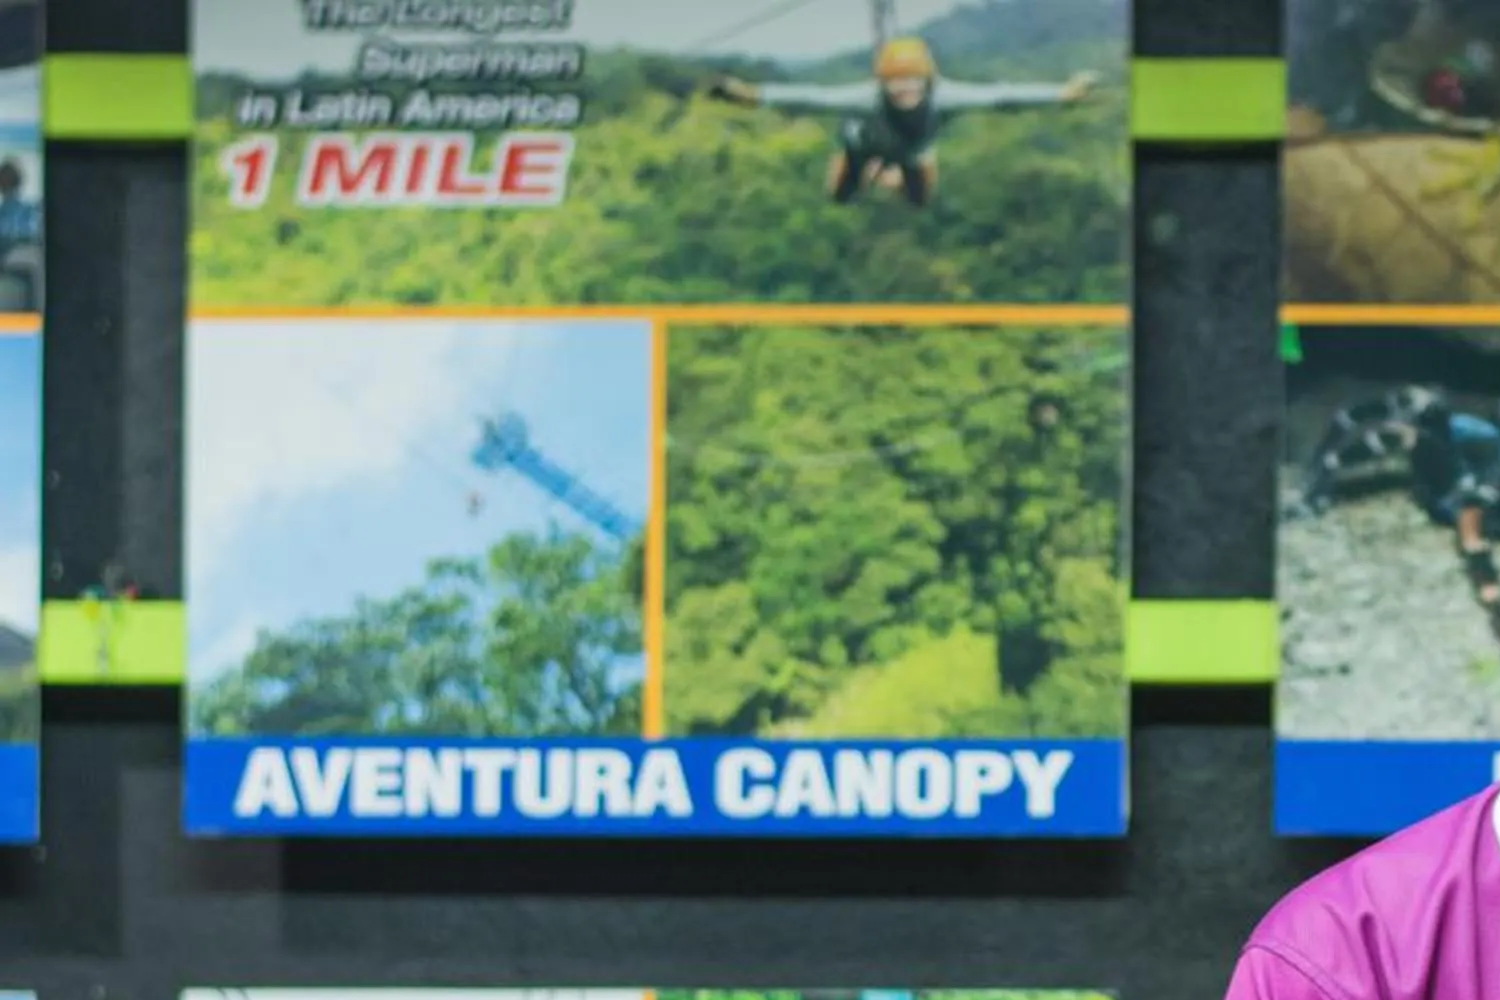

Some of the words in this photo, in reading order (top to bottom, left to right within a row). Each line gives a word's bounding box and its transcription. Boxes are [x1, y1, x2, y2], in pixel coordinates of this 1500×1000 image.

[361, 46, 582, 80] Superman
[238, 90, 276, 125] in
[286, 90, 393, 125] Latin
[400, 89, 581, 125] America
[226, 138, 271, 200] 1
[302, 138, 568, 200] MILE
[233, 746, 694, 819] AVENTURA
[714, 749, 1075, 820] CANOPY
